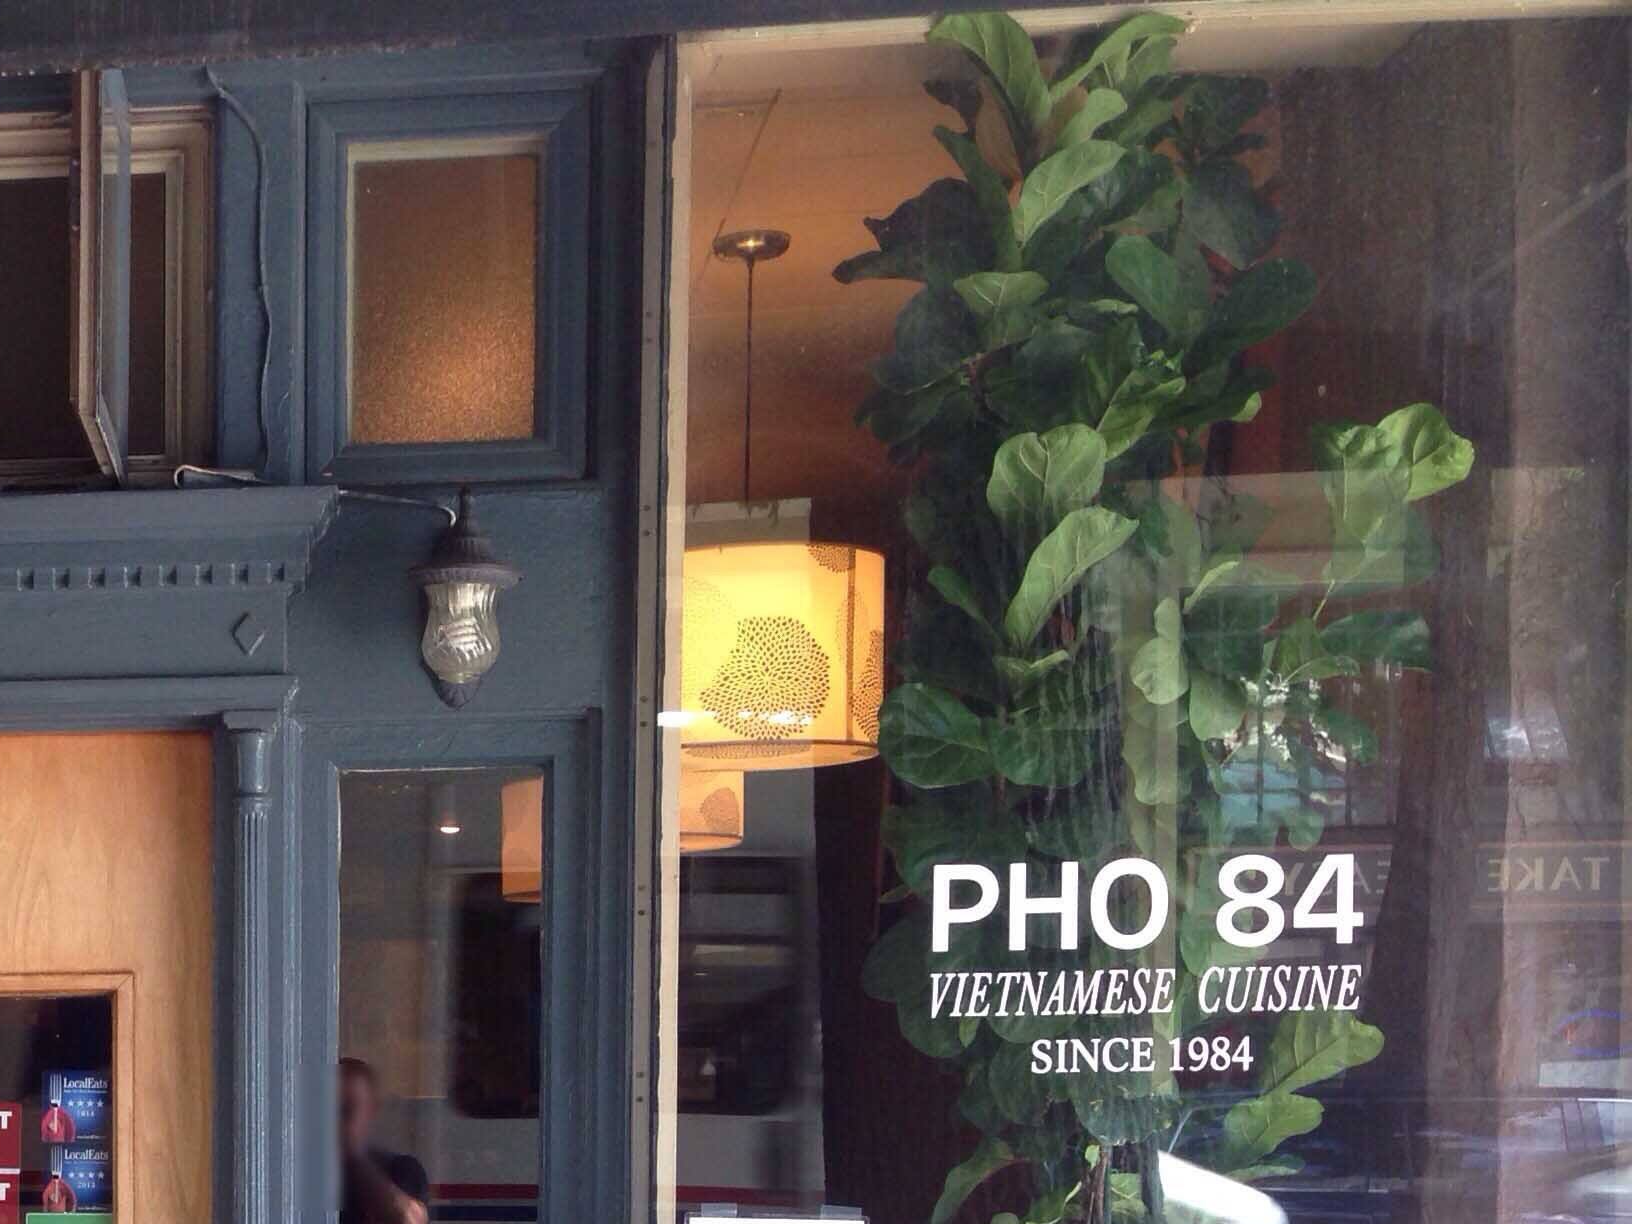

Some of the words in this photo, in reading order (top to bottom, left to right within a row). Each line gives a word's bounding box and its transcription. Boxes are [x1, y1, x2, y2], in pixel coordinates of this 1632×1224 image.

[931, 857, 1169, 953] PHO
[1216, 853, 1365, 948] 84
[929, 967, 1176, 1019] VIETNAMESE
[1199, 964, 1363, 1013] CUISINE
[1030, 1036, 1157, 1074] SINCE
[1169, 1035, 1254, 1073] 1984
[63, 1077, 108, 1089] LocalEats
[64, 1148, 109, 1160] LocalEats
